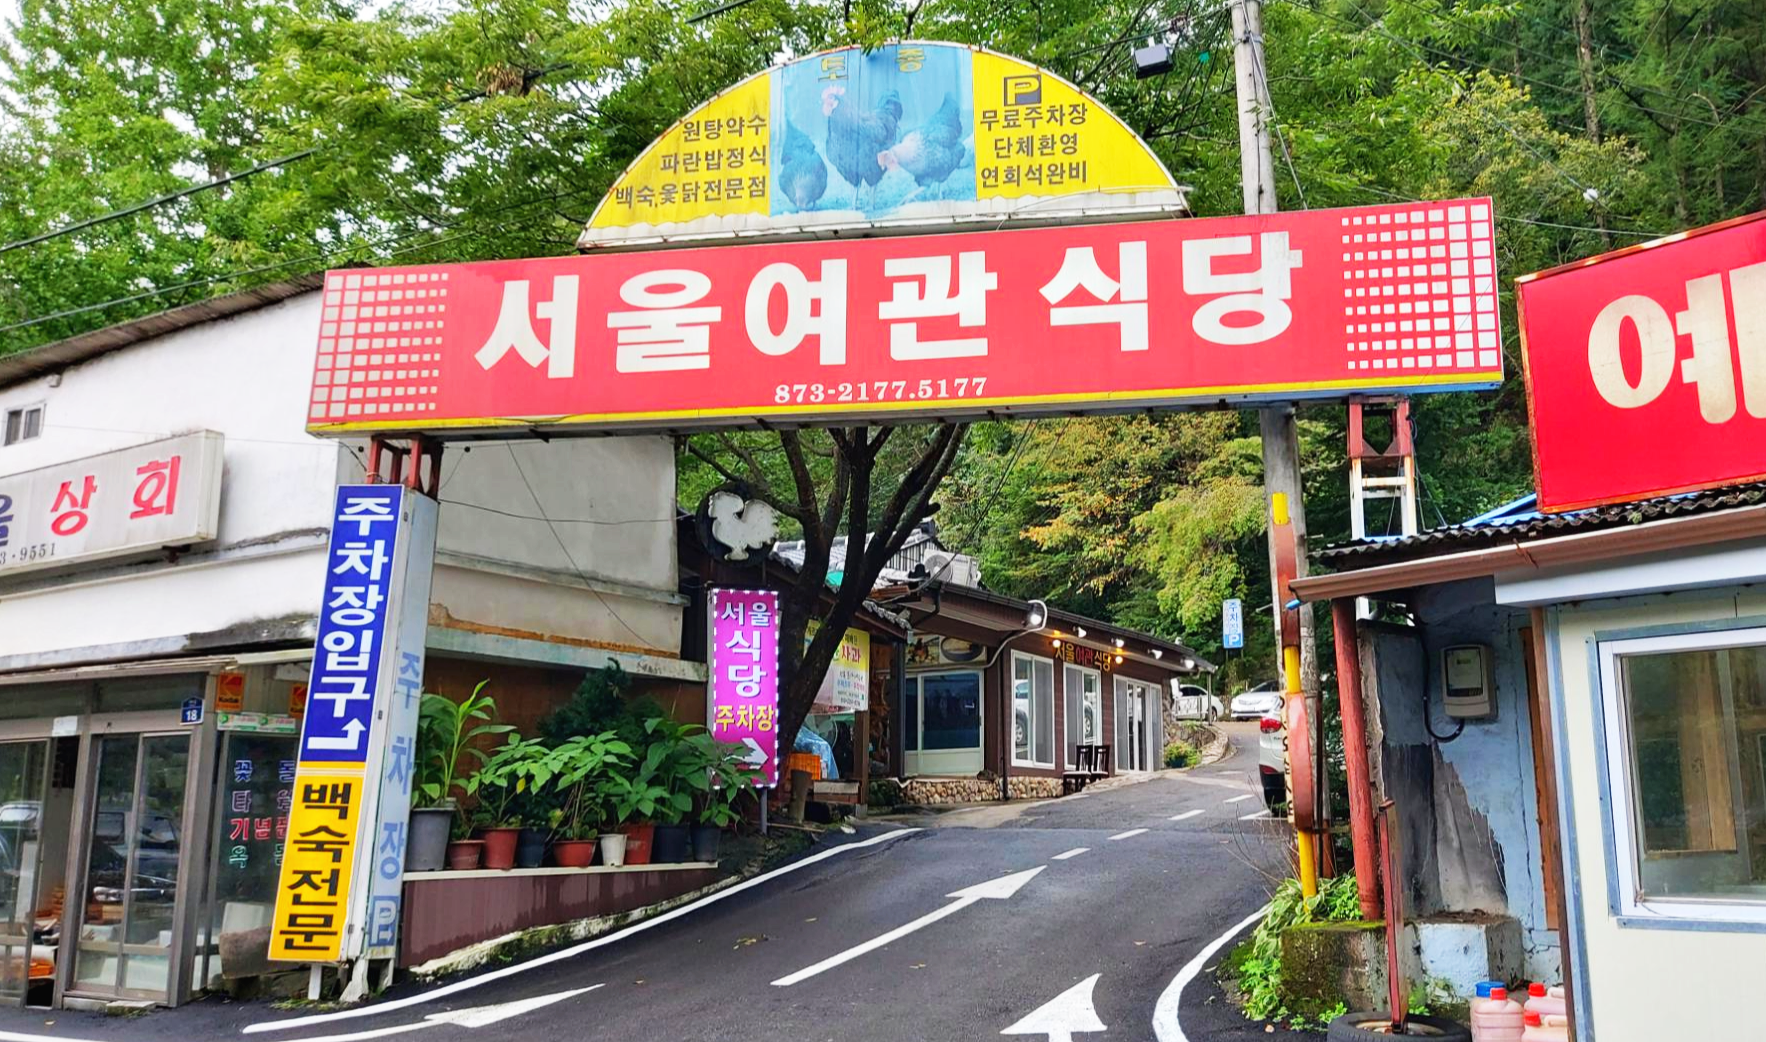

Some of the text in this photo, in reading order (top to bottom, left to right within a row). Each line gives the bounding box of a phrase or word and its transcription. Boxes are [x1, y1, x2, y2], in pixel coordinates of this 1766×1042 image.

[1006, 77, 1040, 105] P
[683, 114, 767, 143] 원탕약수
[980, 102, 1088, 132] 무료주차장
[660, 144, 767, 174] 파란밥정식
[994, 132, 1078, 159] 단체환영
[980, 160, 1087, 189] 연회석완비
[474, 230, 1303, 380] 서울여관식당
[774, 376, 988, 404] 873-2177.5177
[313, 497, 395, 718] 주차장입구
[721, 602, 773, 627] 서울
[1229, 634, 1240, 646] P
[725, 630, 767, 698] 식당
[185, 709, 198, 721] 18
[715, 704, 775, 732] 주차장
[378, 651, 421, 881] 주차장
[279, 783, 352, 951] 백숙전문
